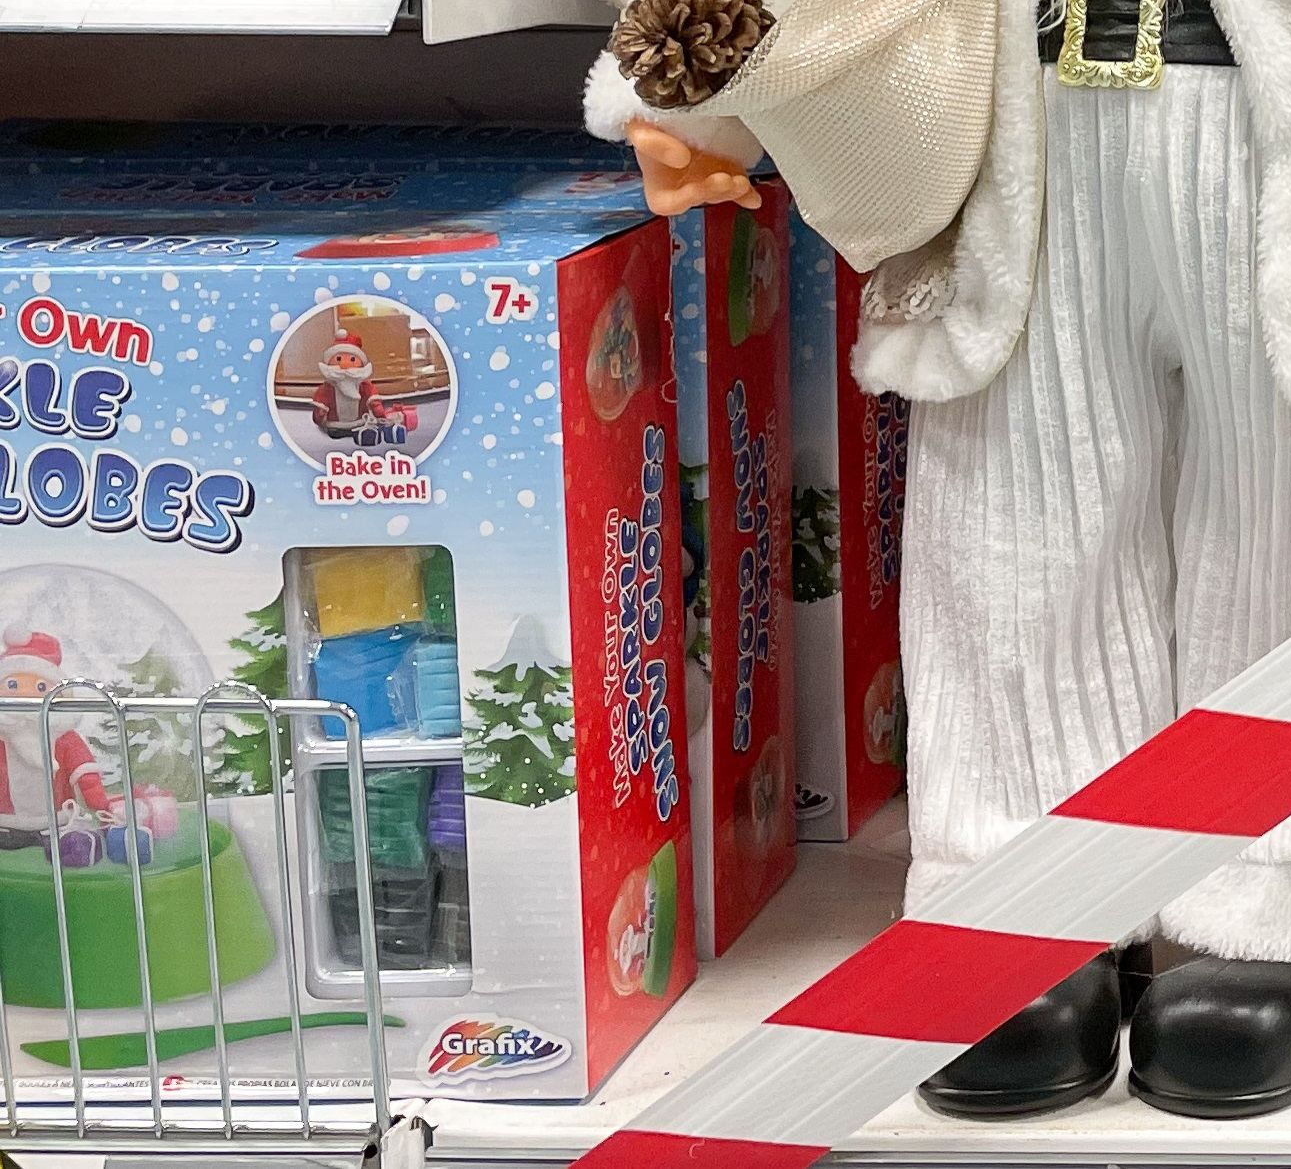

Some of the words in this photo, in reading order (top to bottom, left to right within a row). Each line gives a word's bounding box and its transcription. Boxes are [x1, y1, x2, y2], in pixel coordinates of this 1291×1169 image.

[18, 297, 152, 365] Own
[490, 284, 531, 317] 7+
[317, 481, 355, 500] the
[361, 480, 426, 500] Oven!
[330, 456, 383, 477] Bake
[391, 456, 412, 476] in
[727, 379, 755, 533] SNOW
[600, 508, 620, 604] Own
[640, 424, 665, 645] GLOBES
[752, 432, 770, 662] SPARKLE
[602, 612, 621, 707] Your
[619, 517, 648, 775] SPARKLE
[733, 548, 755, 753] GLOBES
[610, 703, 631, 809] Make
[644, 659, 678, 822] SNOW
[441, 1032, 535, 1056] Grafix
